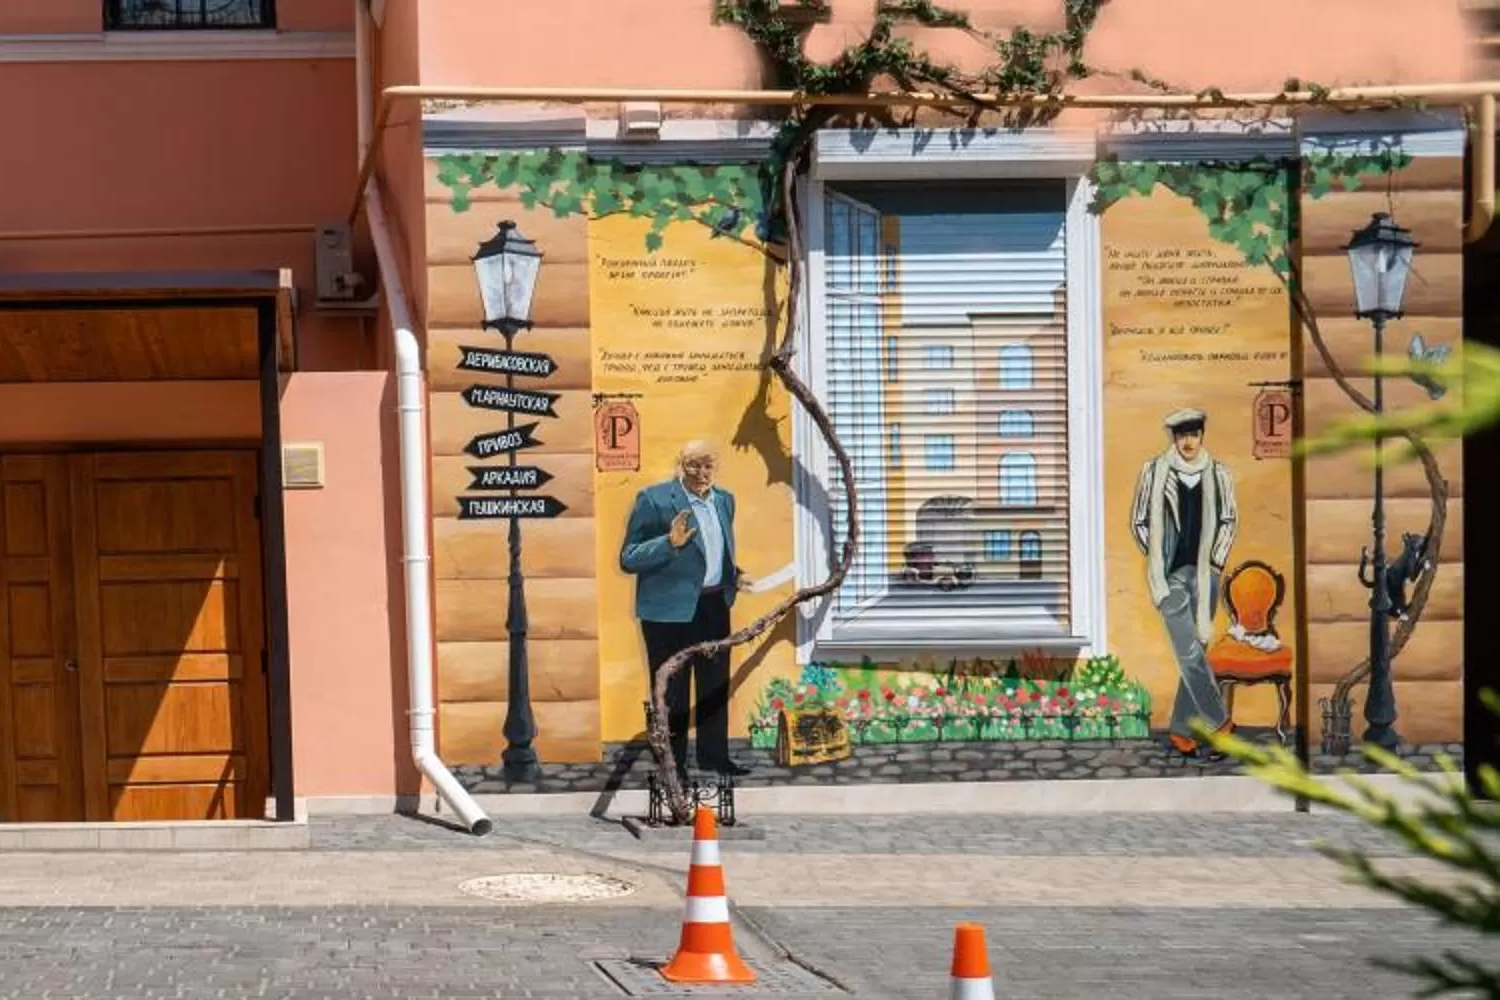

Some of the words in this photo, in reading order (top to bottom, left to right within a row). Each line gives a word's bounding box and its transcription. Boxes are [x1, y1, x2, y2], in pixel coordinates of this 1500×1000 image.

[465, 352, 549, 373] ДЕРИБАСОВСКАЯ
[1267, 403, 1289, 437] P
[477, 431, 523, 454] ПРИВОЗ
[608, 415, 633, 449] P
[481, 470, 537, 486] АРКАДИЯ
[468, 499, 546, 515] ПУШКИНСКАЯ
